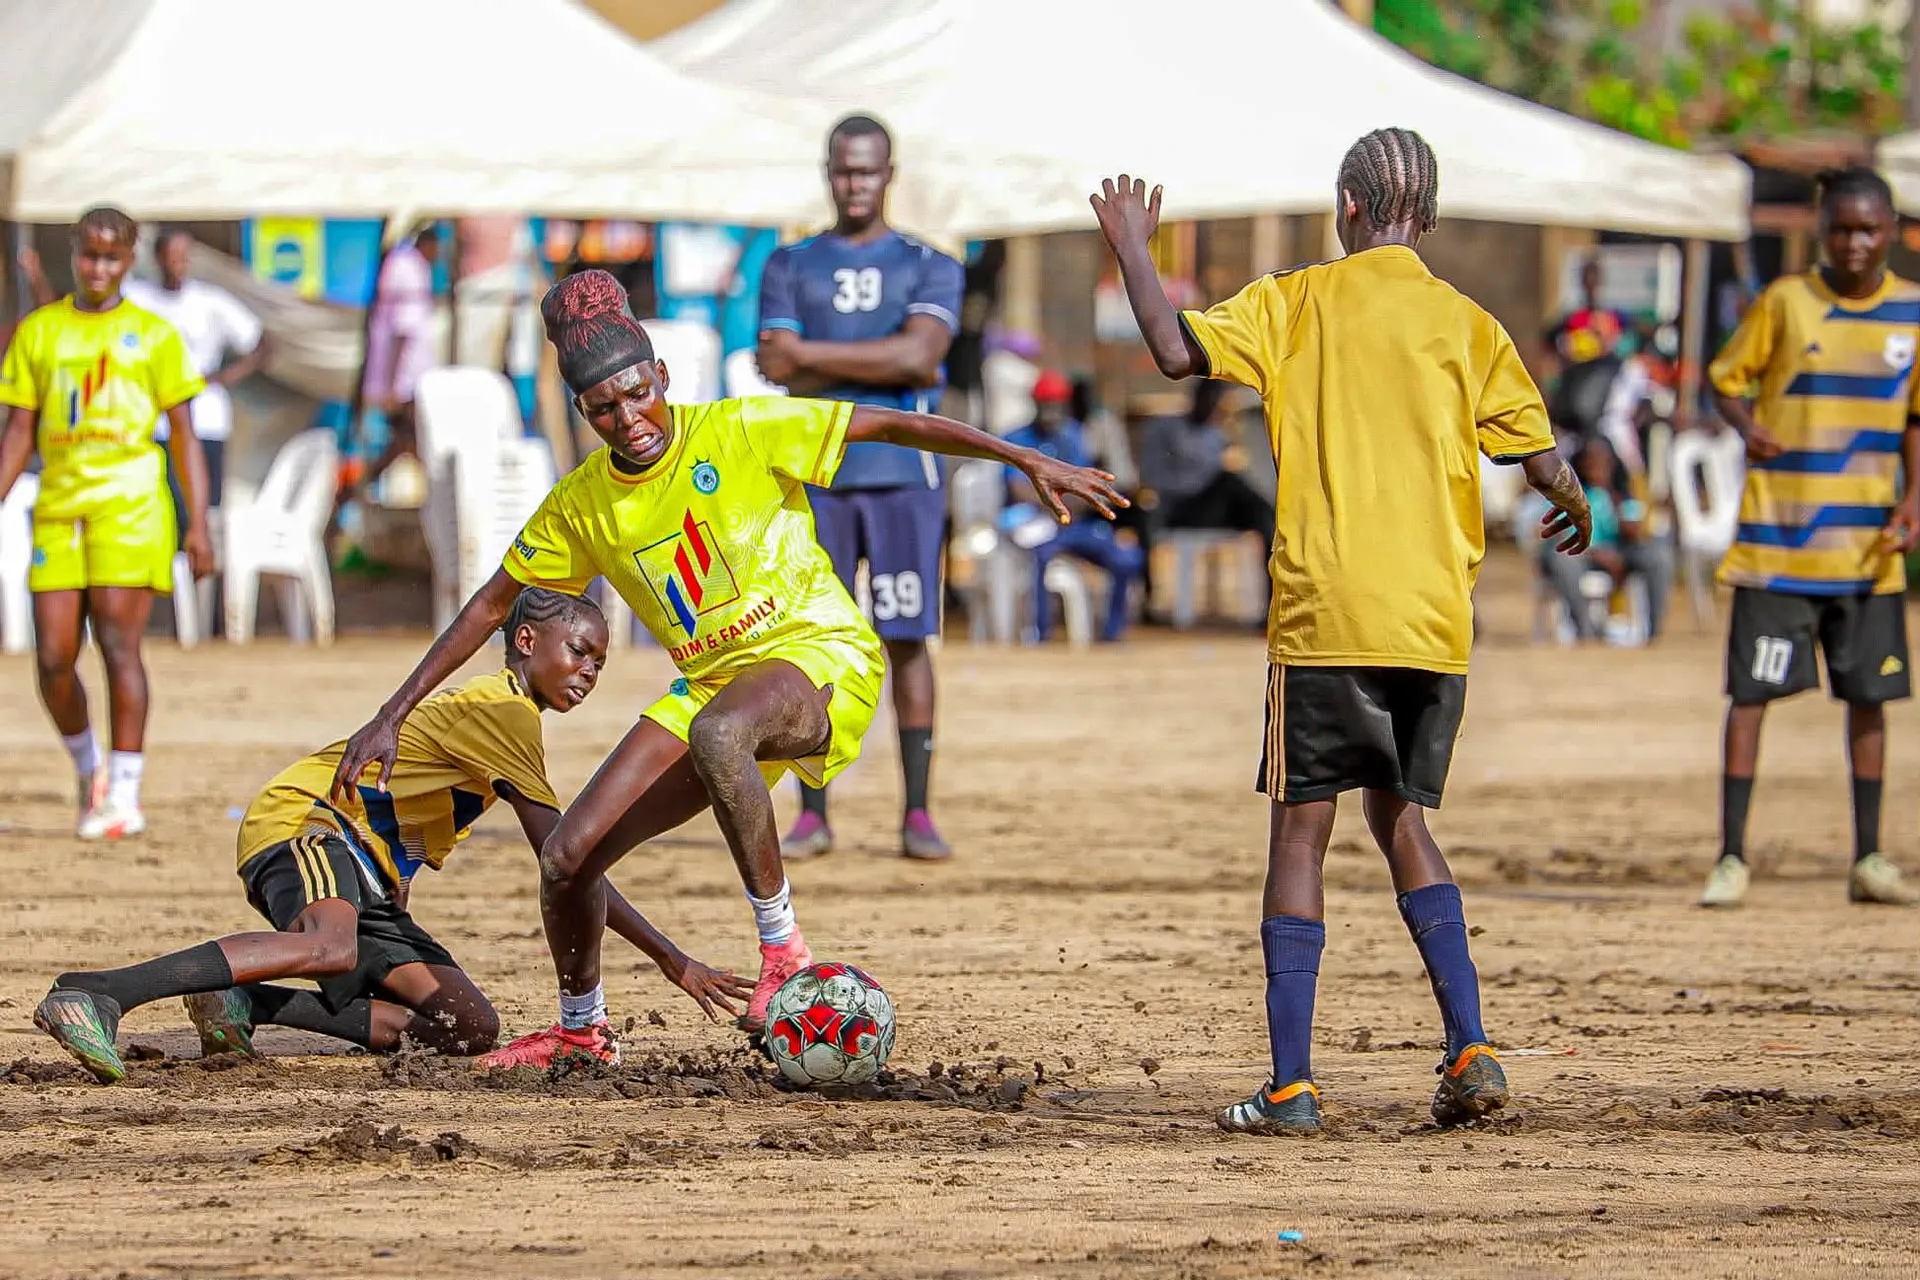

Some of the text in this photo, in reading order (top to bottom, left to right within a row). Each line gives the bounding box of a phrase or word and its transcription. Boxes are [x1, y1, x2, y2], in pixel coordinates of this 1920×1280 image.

[832, 266, 882, 313] 39
[872, 570, 924, 620] 39
[706, 633, 719, 649] &
[719, 596, 776, 642] FAMILY
[766, 611, 786, 629] LTD
[1751, 635, 1793, 684] 10
